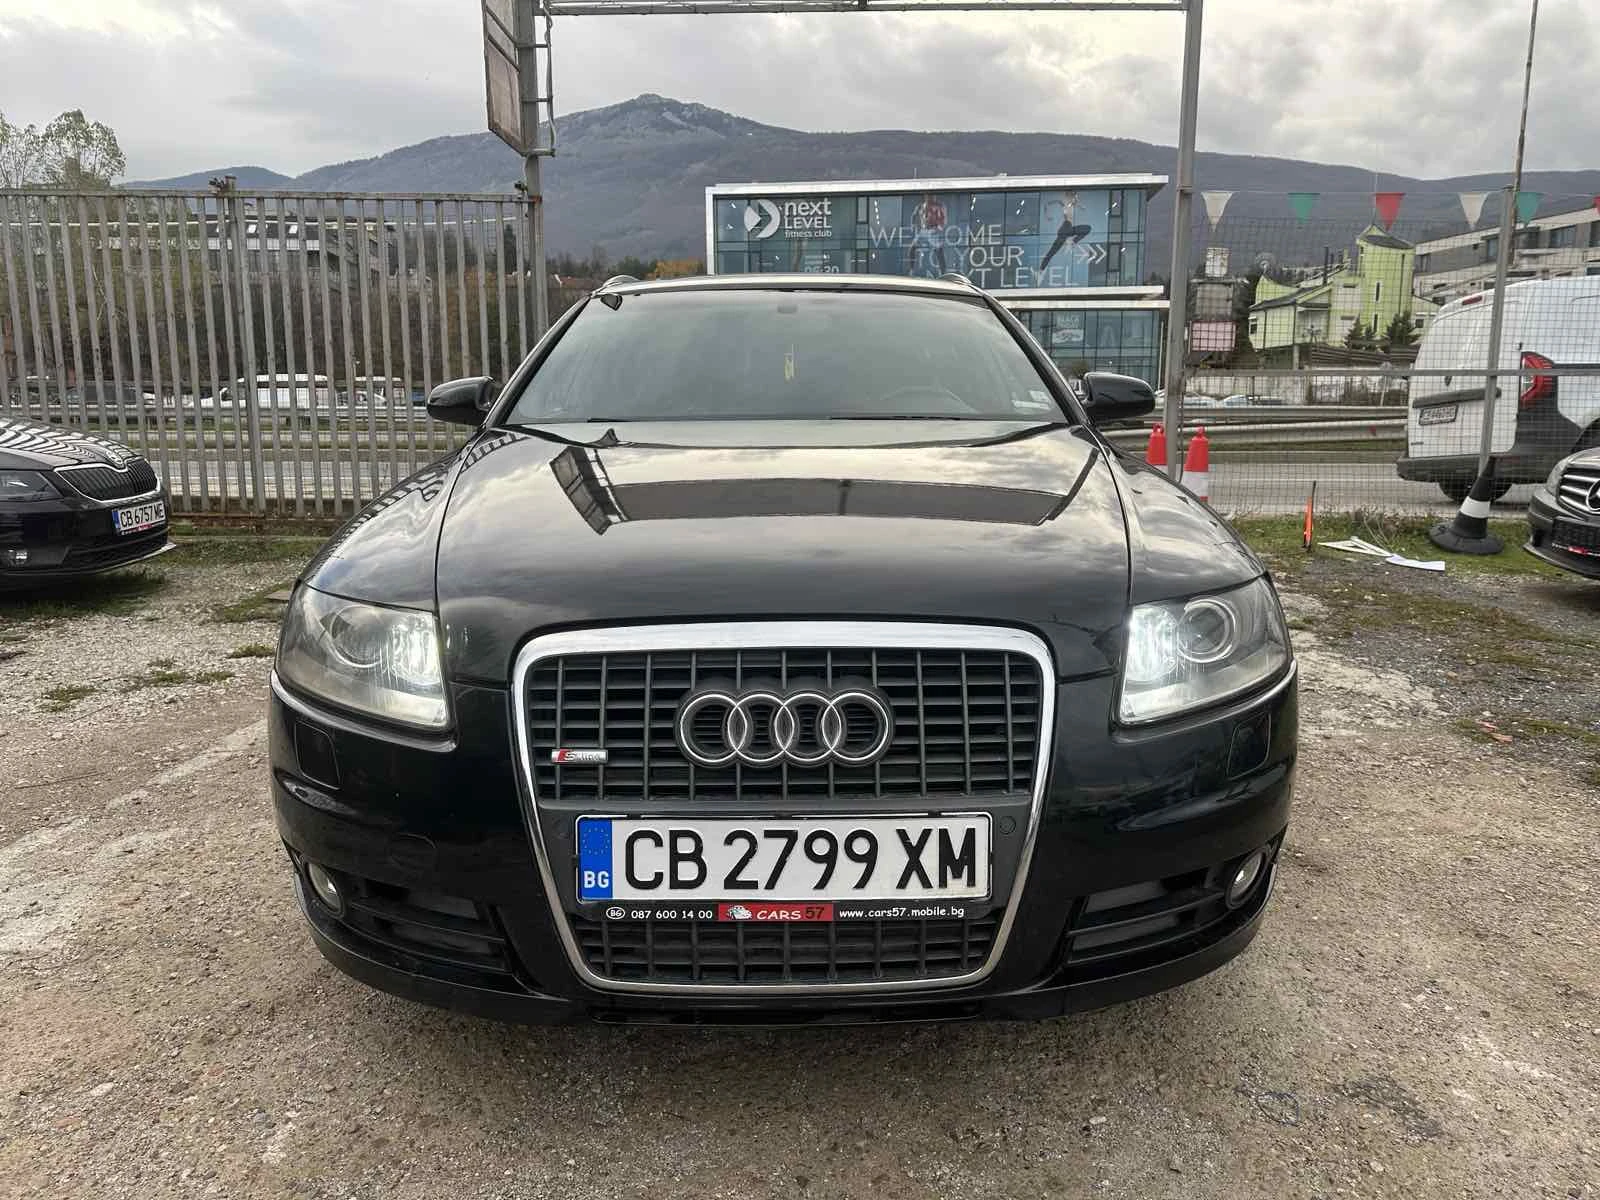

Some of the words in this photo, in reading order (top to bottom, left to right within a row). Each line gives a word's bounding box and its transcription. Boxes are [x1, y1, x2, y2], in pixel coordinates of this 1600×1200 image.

[784, 198, 832, 216] next
[784, 216, 832, 229] LEVEL
[784, 230, 813, 238] fitness
[814, 230, 832, 238] club
[870, 224, 1001, 248] WELCOME
[953, 246, 1024, 267] YOUR
[1000, 265, 1081, 288] LEVEL
[120, 509, 133, 527] CB
[134, 505, 153, 524] 6757
[625, 829, 708, 891] CB
[723, 829, 879, 890] 2799
[895, 827, 976, 890] XM
[584, 870, 609, 889] BG
[609, 909, 623, 918] BG
[631, 910, 651, 919] 087
[655, 910, 677, 919] 600
[682, 910, 694, 919] 14
[698, 910, 713, 919] 00
[757, 909, 801, 920] CARS
[805, 906, 824, 919] 57
[839, 906, 965, 918] www.cars57.mobile.bg
